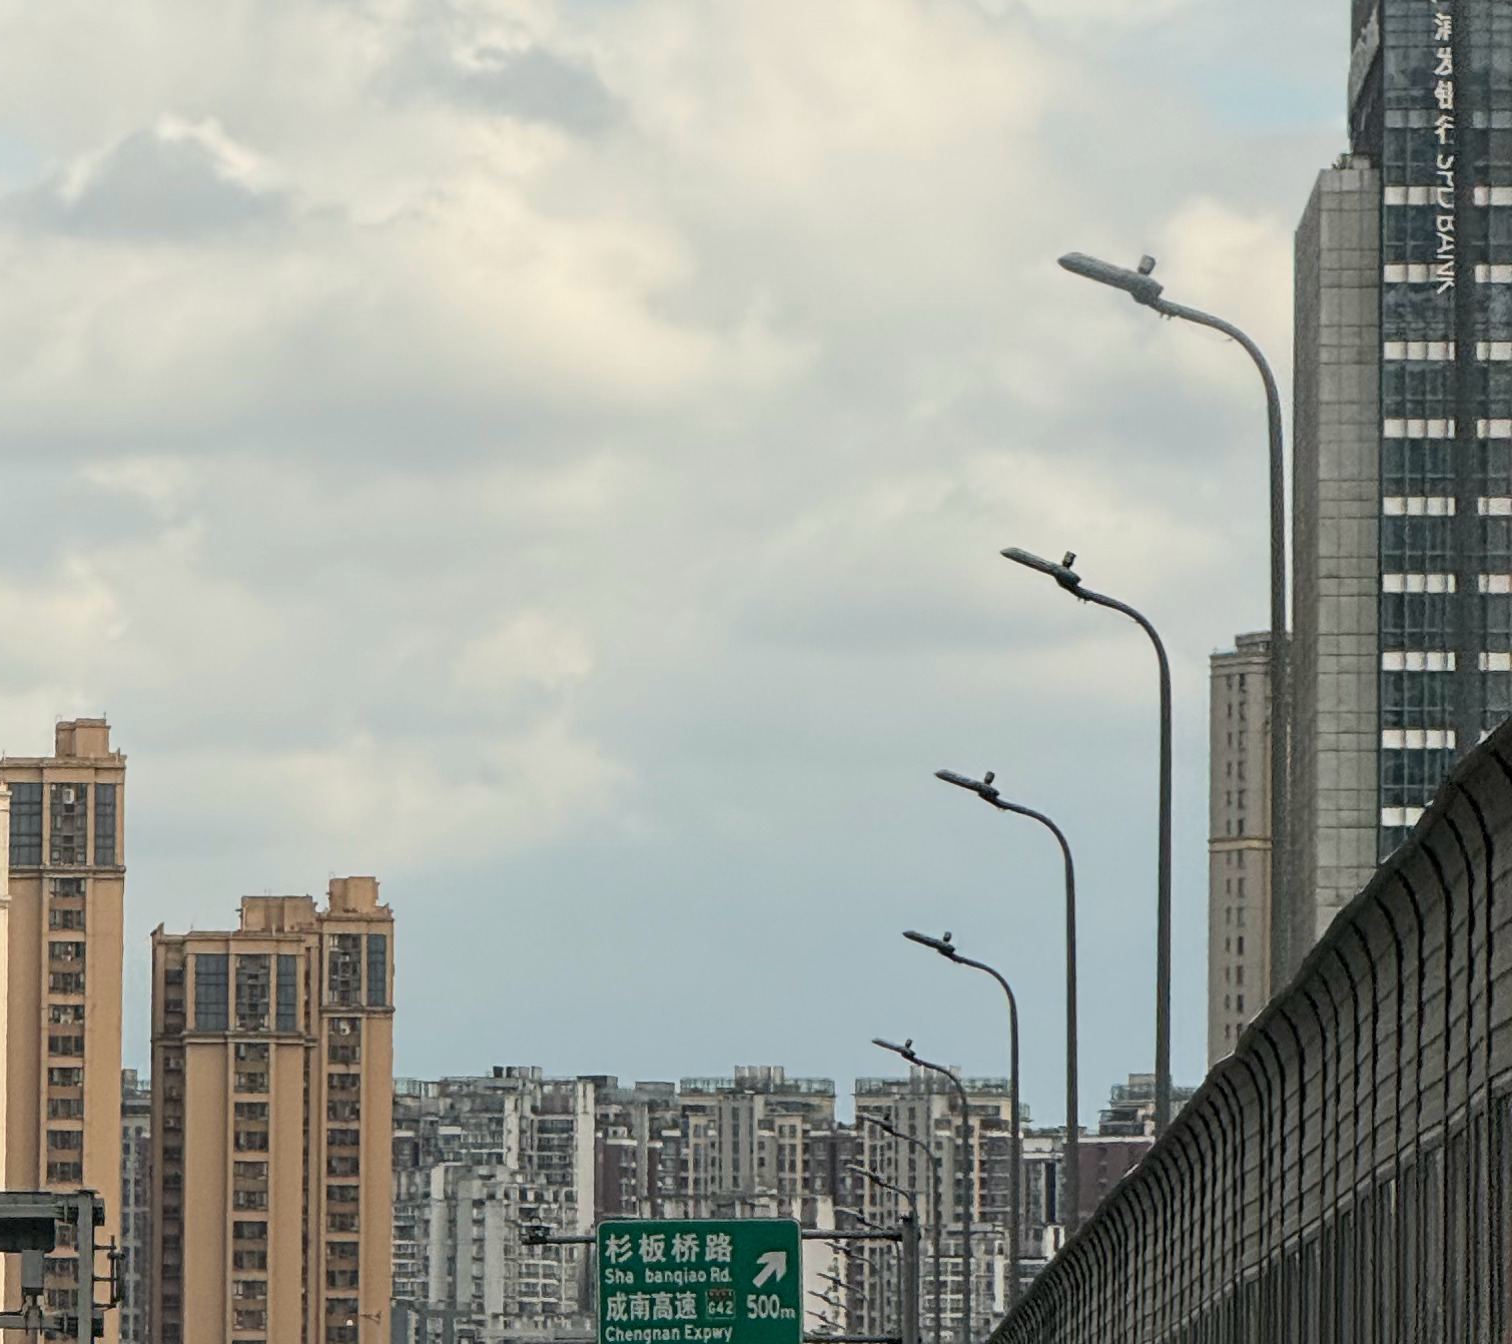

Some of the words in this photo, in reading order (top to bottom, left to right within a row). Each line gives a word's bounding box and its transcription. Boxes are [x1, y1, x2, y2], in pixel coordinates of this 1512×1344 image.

[604, 1232, 734, 1264] 杉板桥路
[604, 1268, 635, 1285] Sha
[644, 1266, 707, 1287] banqiao
[606, 1290, 698, 1322] 成南高速
[708, 1300, 734, 1315] G42
[746, 1293, 796, 1320] 500m
[684, 1323, 734, 1343] Expwy
